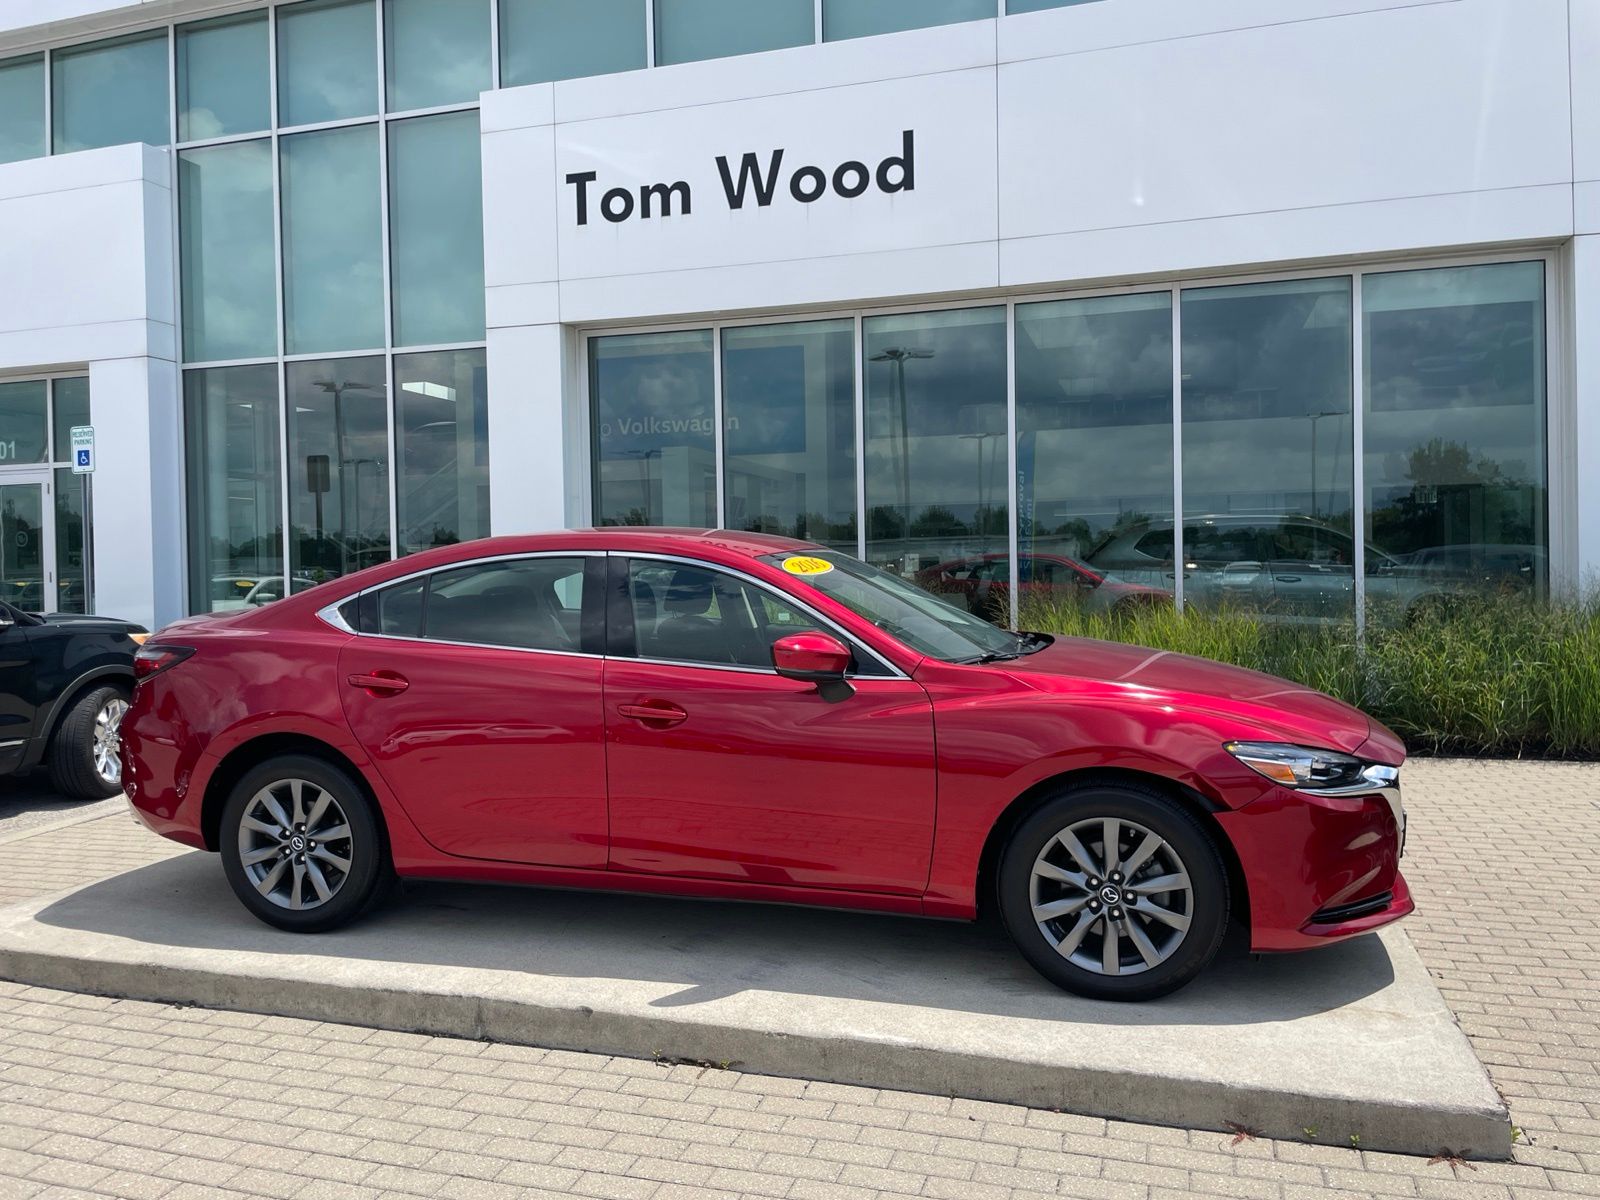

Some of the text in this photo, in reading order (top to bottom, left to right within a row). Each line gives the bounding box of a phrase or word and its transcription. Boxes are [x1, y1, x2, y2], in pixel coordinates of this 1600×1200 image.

[565, 129, 915, 226] Tom Wood
[617, 415, 740, 436] Volkswagn
